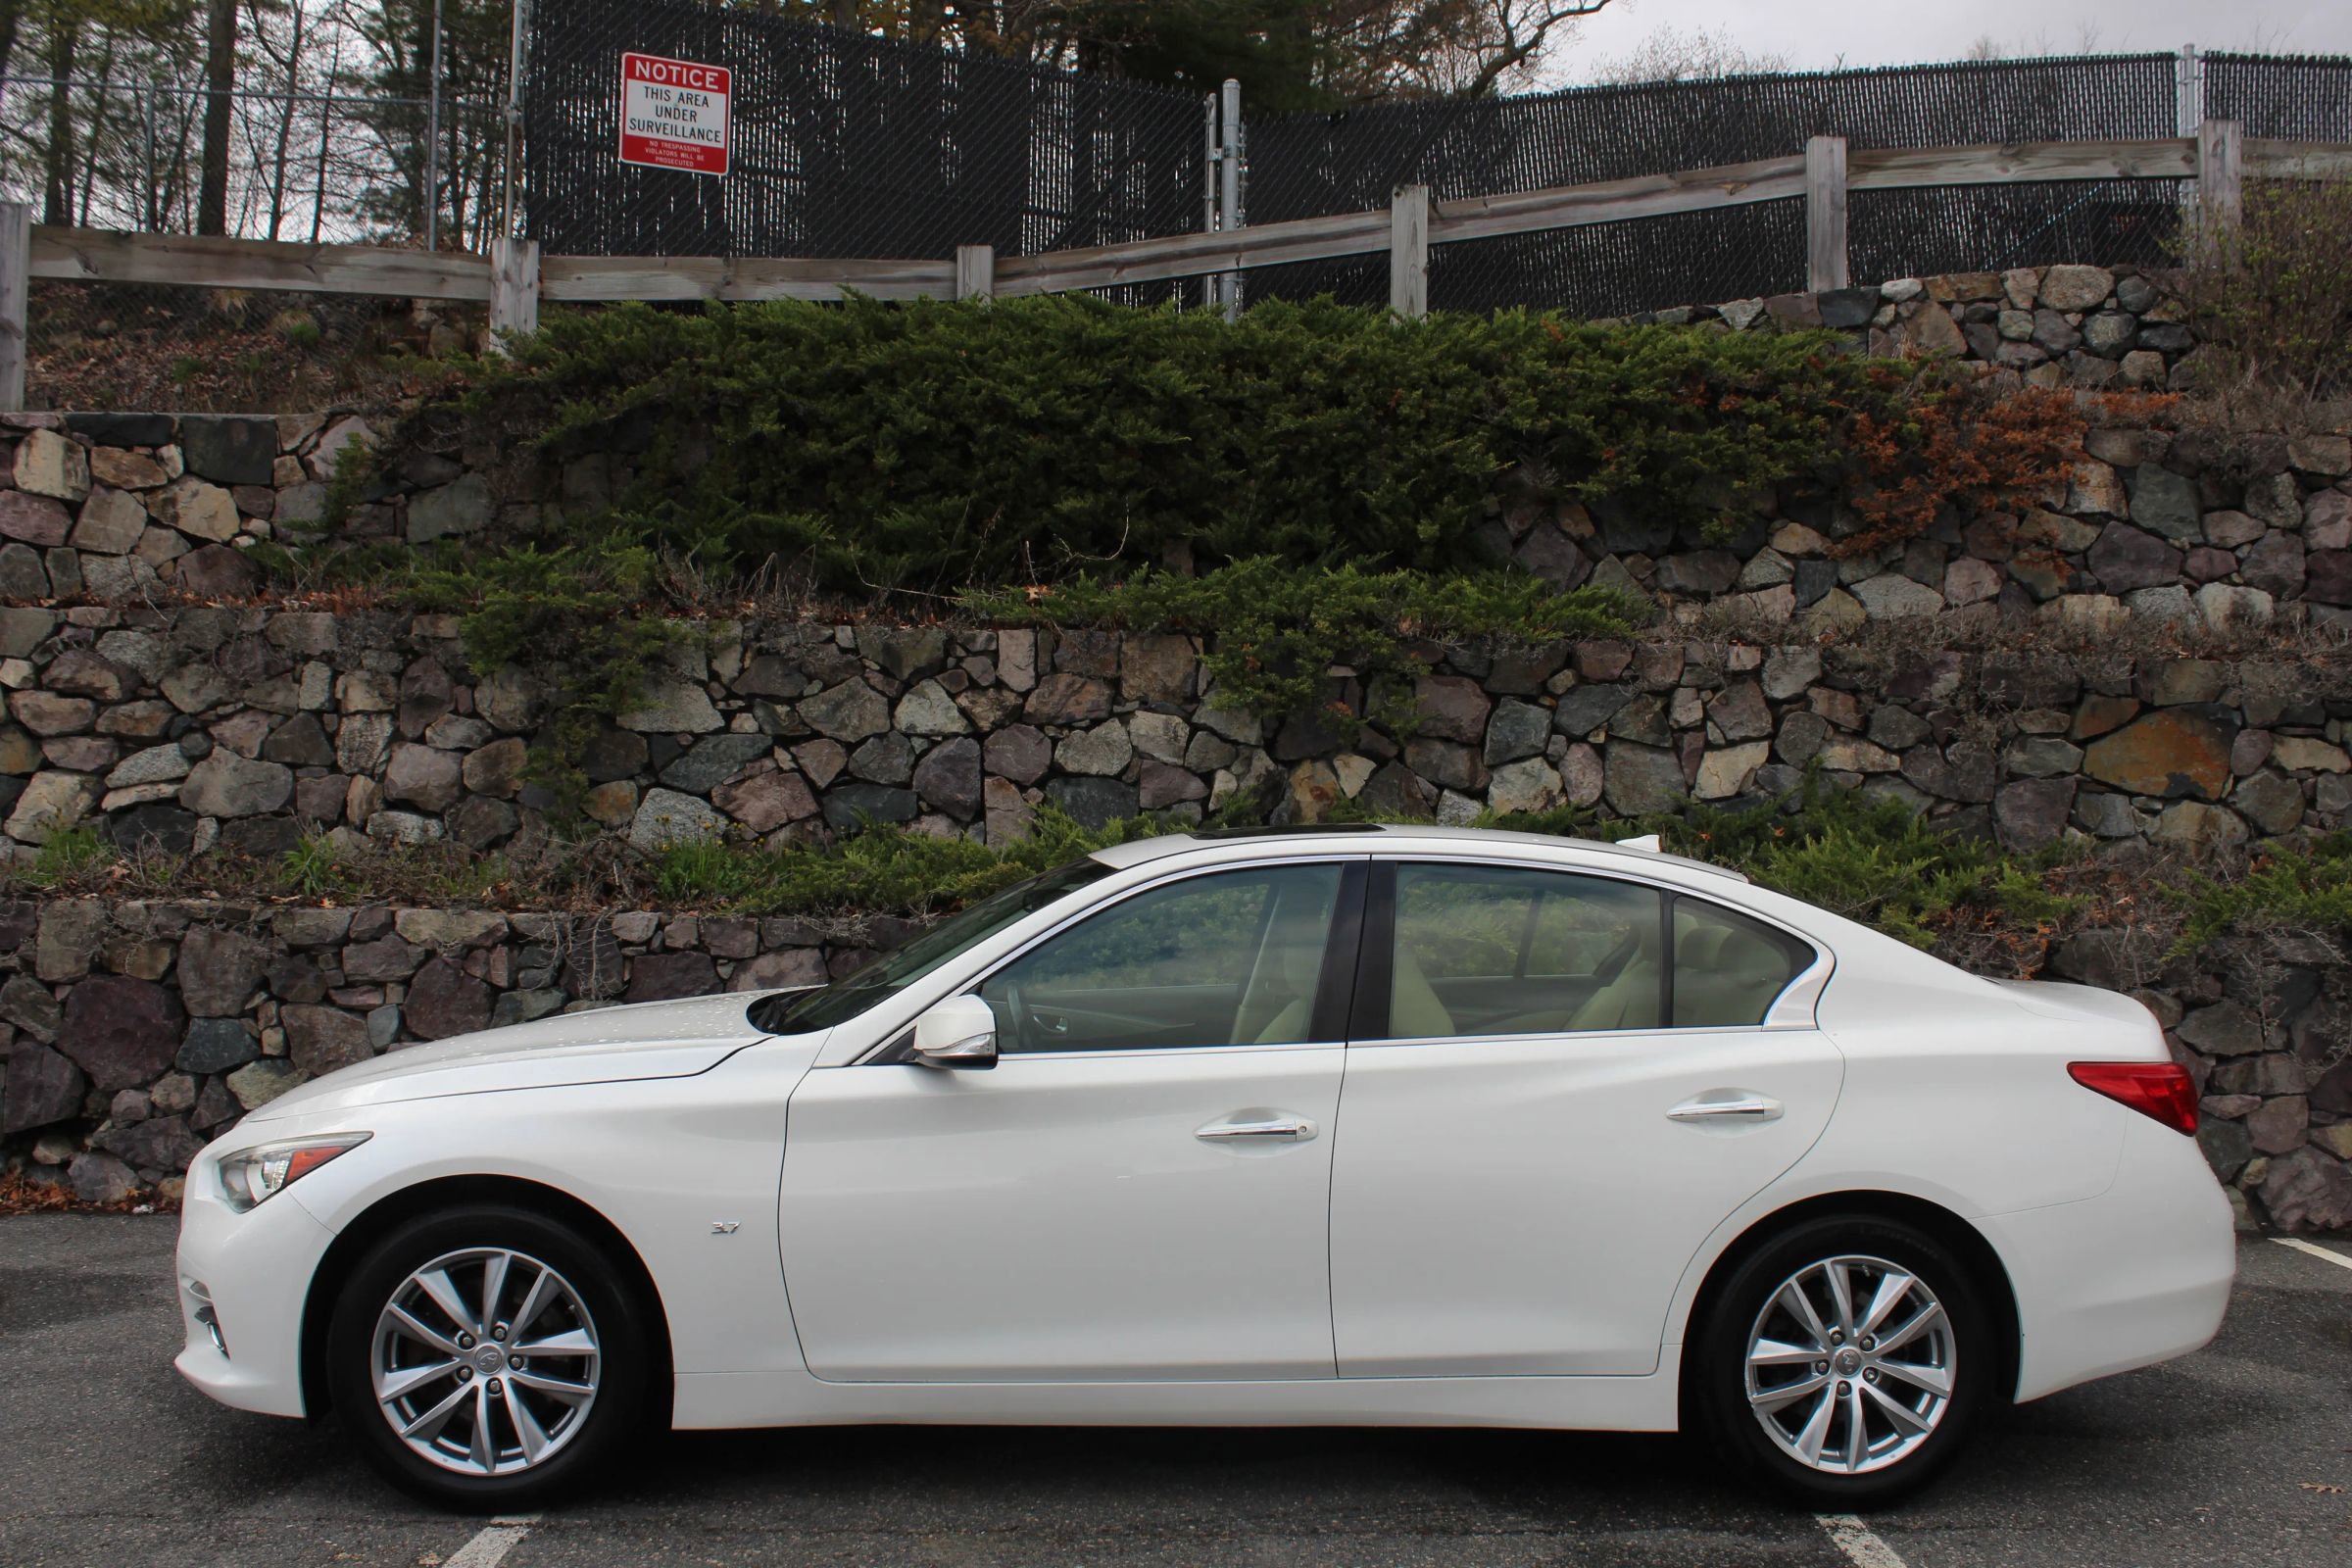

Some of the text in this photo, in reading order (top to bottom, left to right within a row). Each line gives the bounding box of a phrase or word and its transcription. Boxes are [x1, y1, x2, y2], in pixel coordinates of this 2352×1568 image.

[635, 60, 718, 89] NOTICE
[644, 85, 709, 108] THIS AREA
[655, 105, 697, 122] UNDER
[629, 118, 721, 142] SURVEILLANCE
[645, 147, 678, 158] VIOLATORS
[680, 152, 695, 161] WILL
[662, 141, 701, 153] TRESPASSING
[655, 157, 695, 168] PROSECUTED
